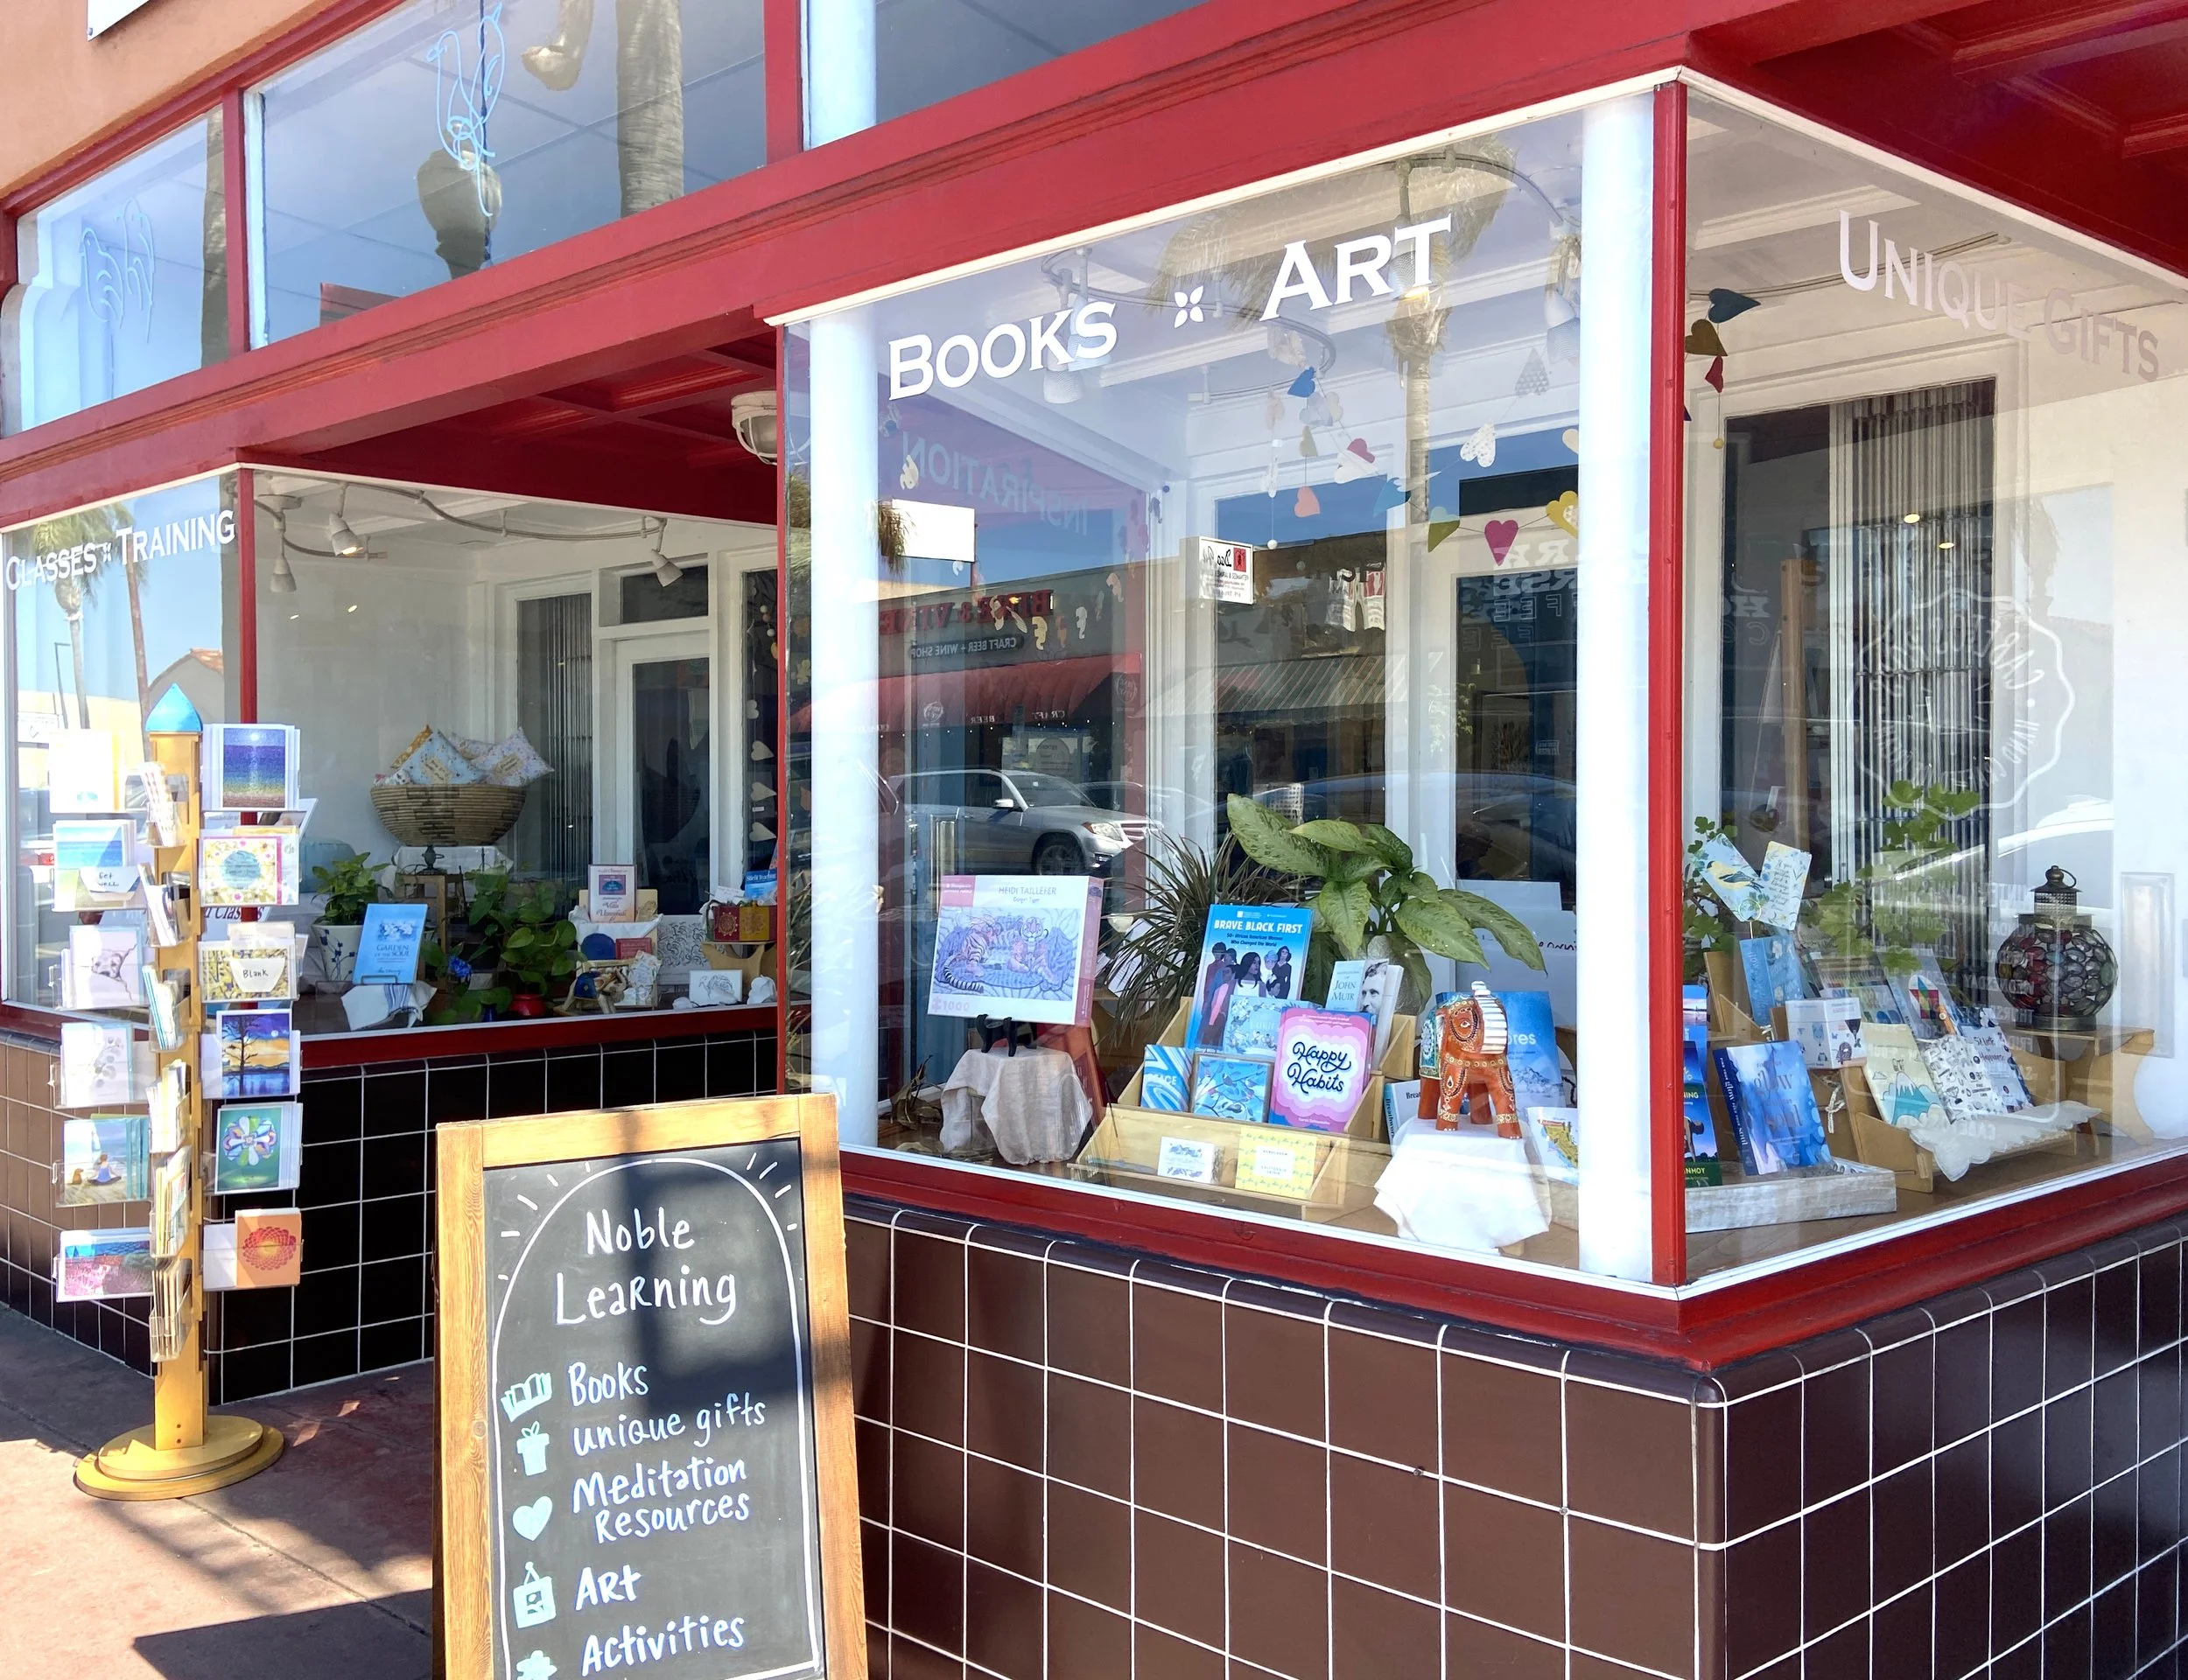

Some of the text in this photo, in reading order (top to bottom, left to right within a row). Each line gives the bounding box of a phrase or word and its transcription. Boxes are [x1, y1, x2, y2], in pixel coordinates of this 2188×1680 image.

[888, 213, 1453, 401] BOOKS ART
[1838, 210, 2160, 382] UNIQUE GIFTS
[6, 508, 237, 592] CLASSES TRAINING
[999, 886, 1020, 895] HEIDI
[1214, 920, 1303, 934] BRAVE BLACK FIRST
[242, 969, 269, 977] Blank
[1333, 980, 1356, 990] JOHN
[1287, 1062, 1344, 1094] Habits
[1293, 1041, 1352, 1072] Happy
[586, 1207, 696, 1256] Noble
[567, 1362, 649, 1407] Books
[696, 1391, 767, 1447] gifts
[572, 1455, 747, 1515] Meditation
[594, 1489, 751, 1544] Resources
[580, 1614, 745, 1676] Activities
